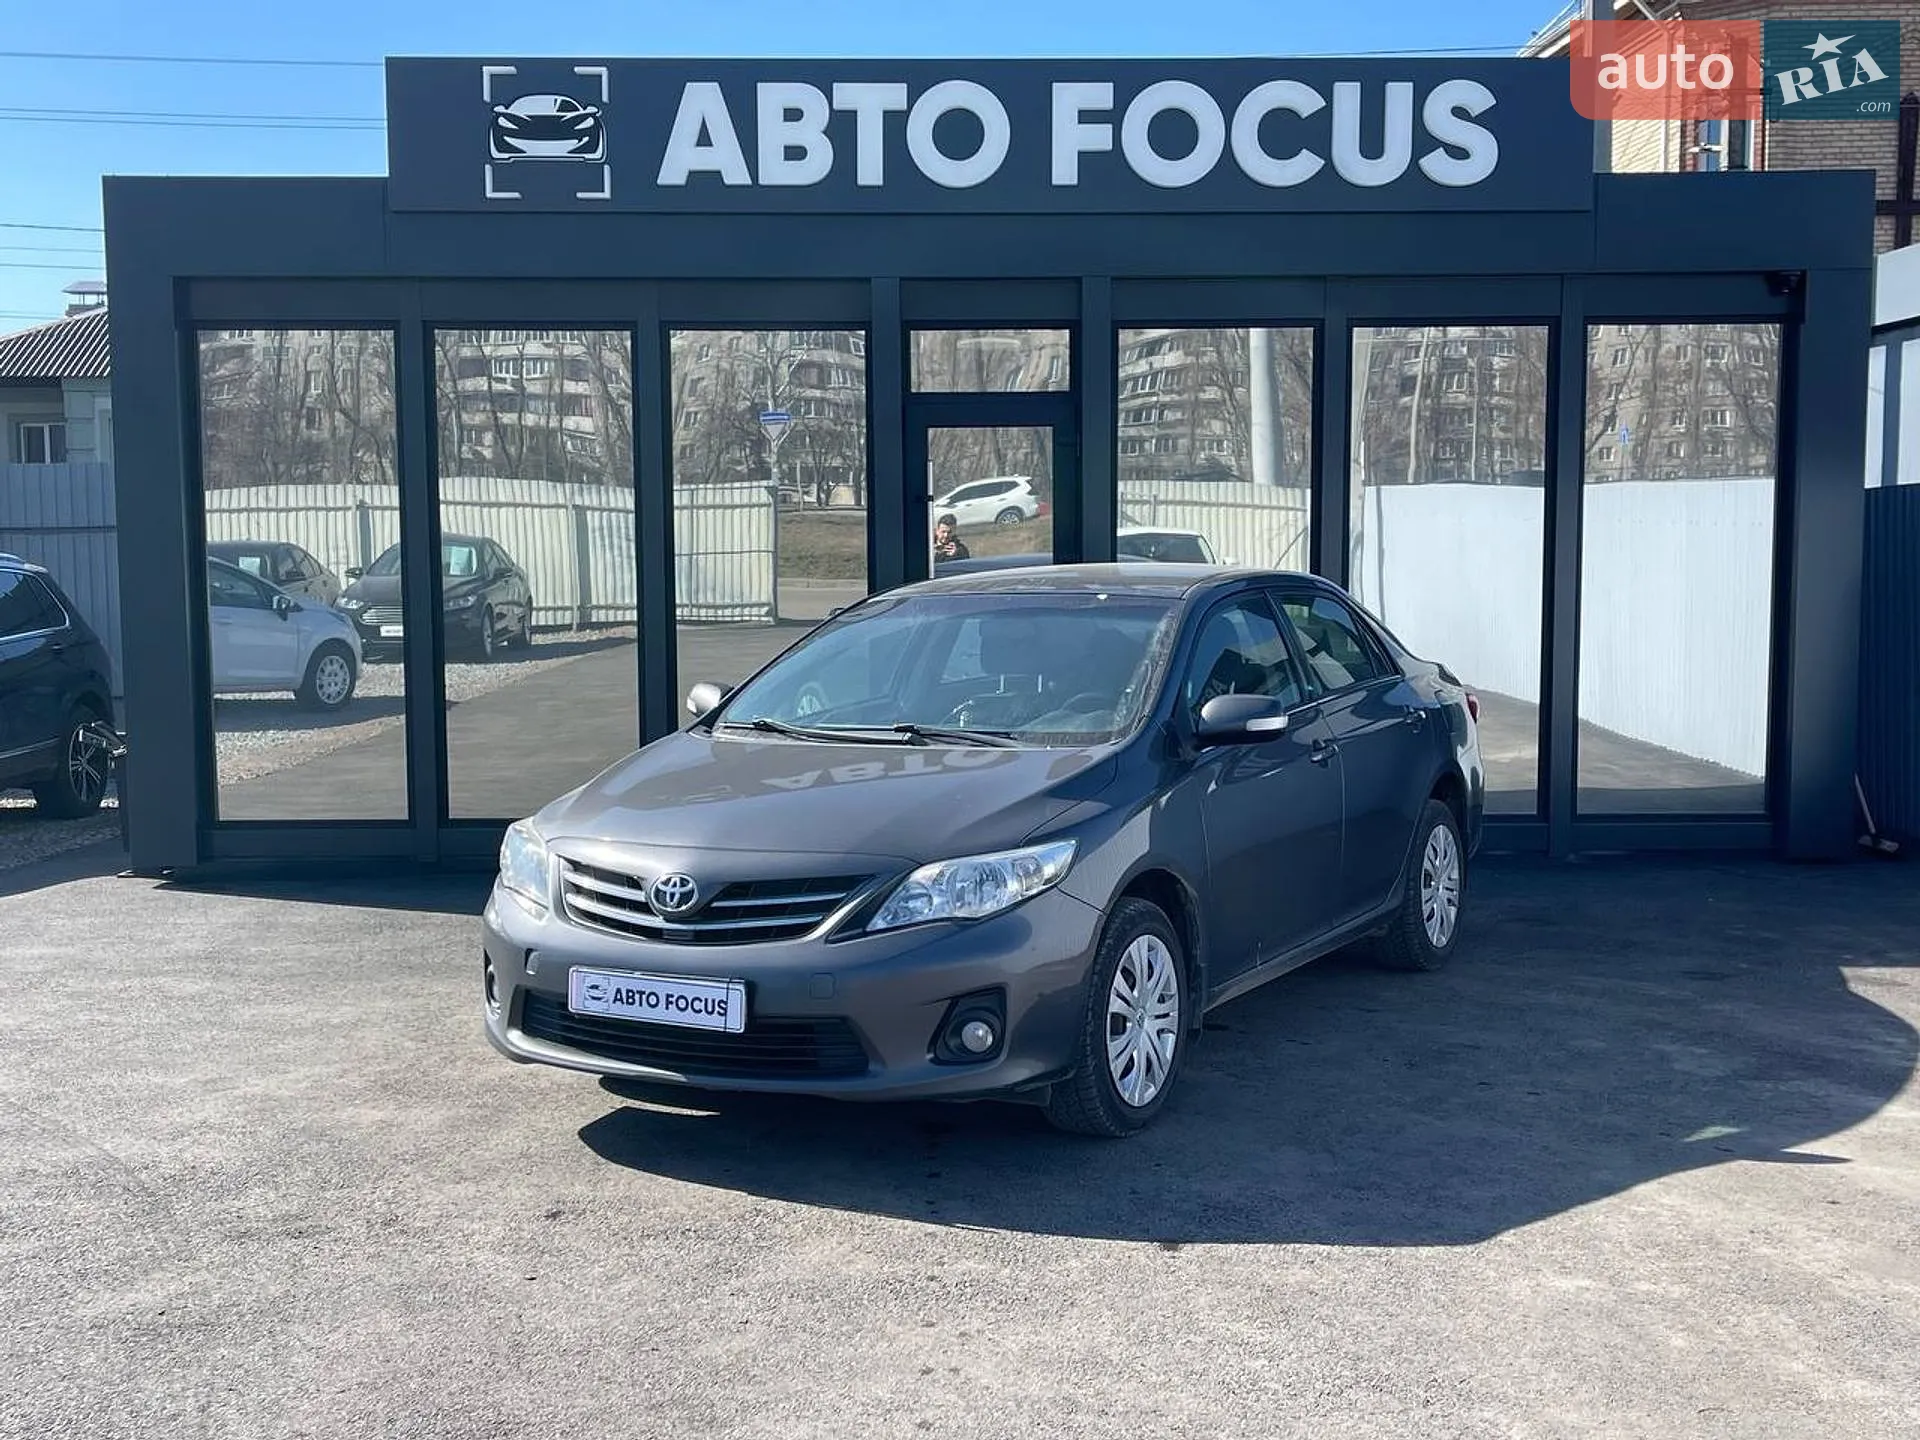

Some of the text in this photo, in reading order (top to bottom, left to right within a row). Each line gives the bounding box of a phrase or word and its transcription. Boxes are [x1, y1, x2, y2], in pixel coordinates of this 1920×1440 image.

[656, 79, 1499, 188] АВТО FOCUS
[612, 987, 728, 1017] АВТО FOCUS
